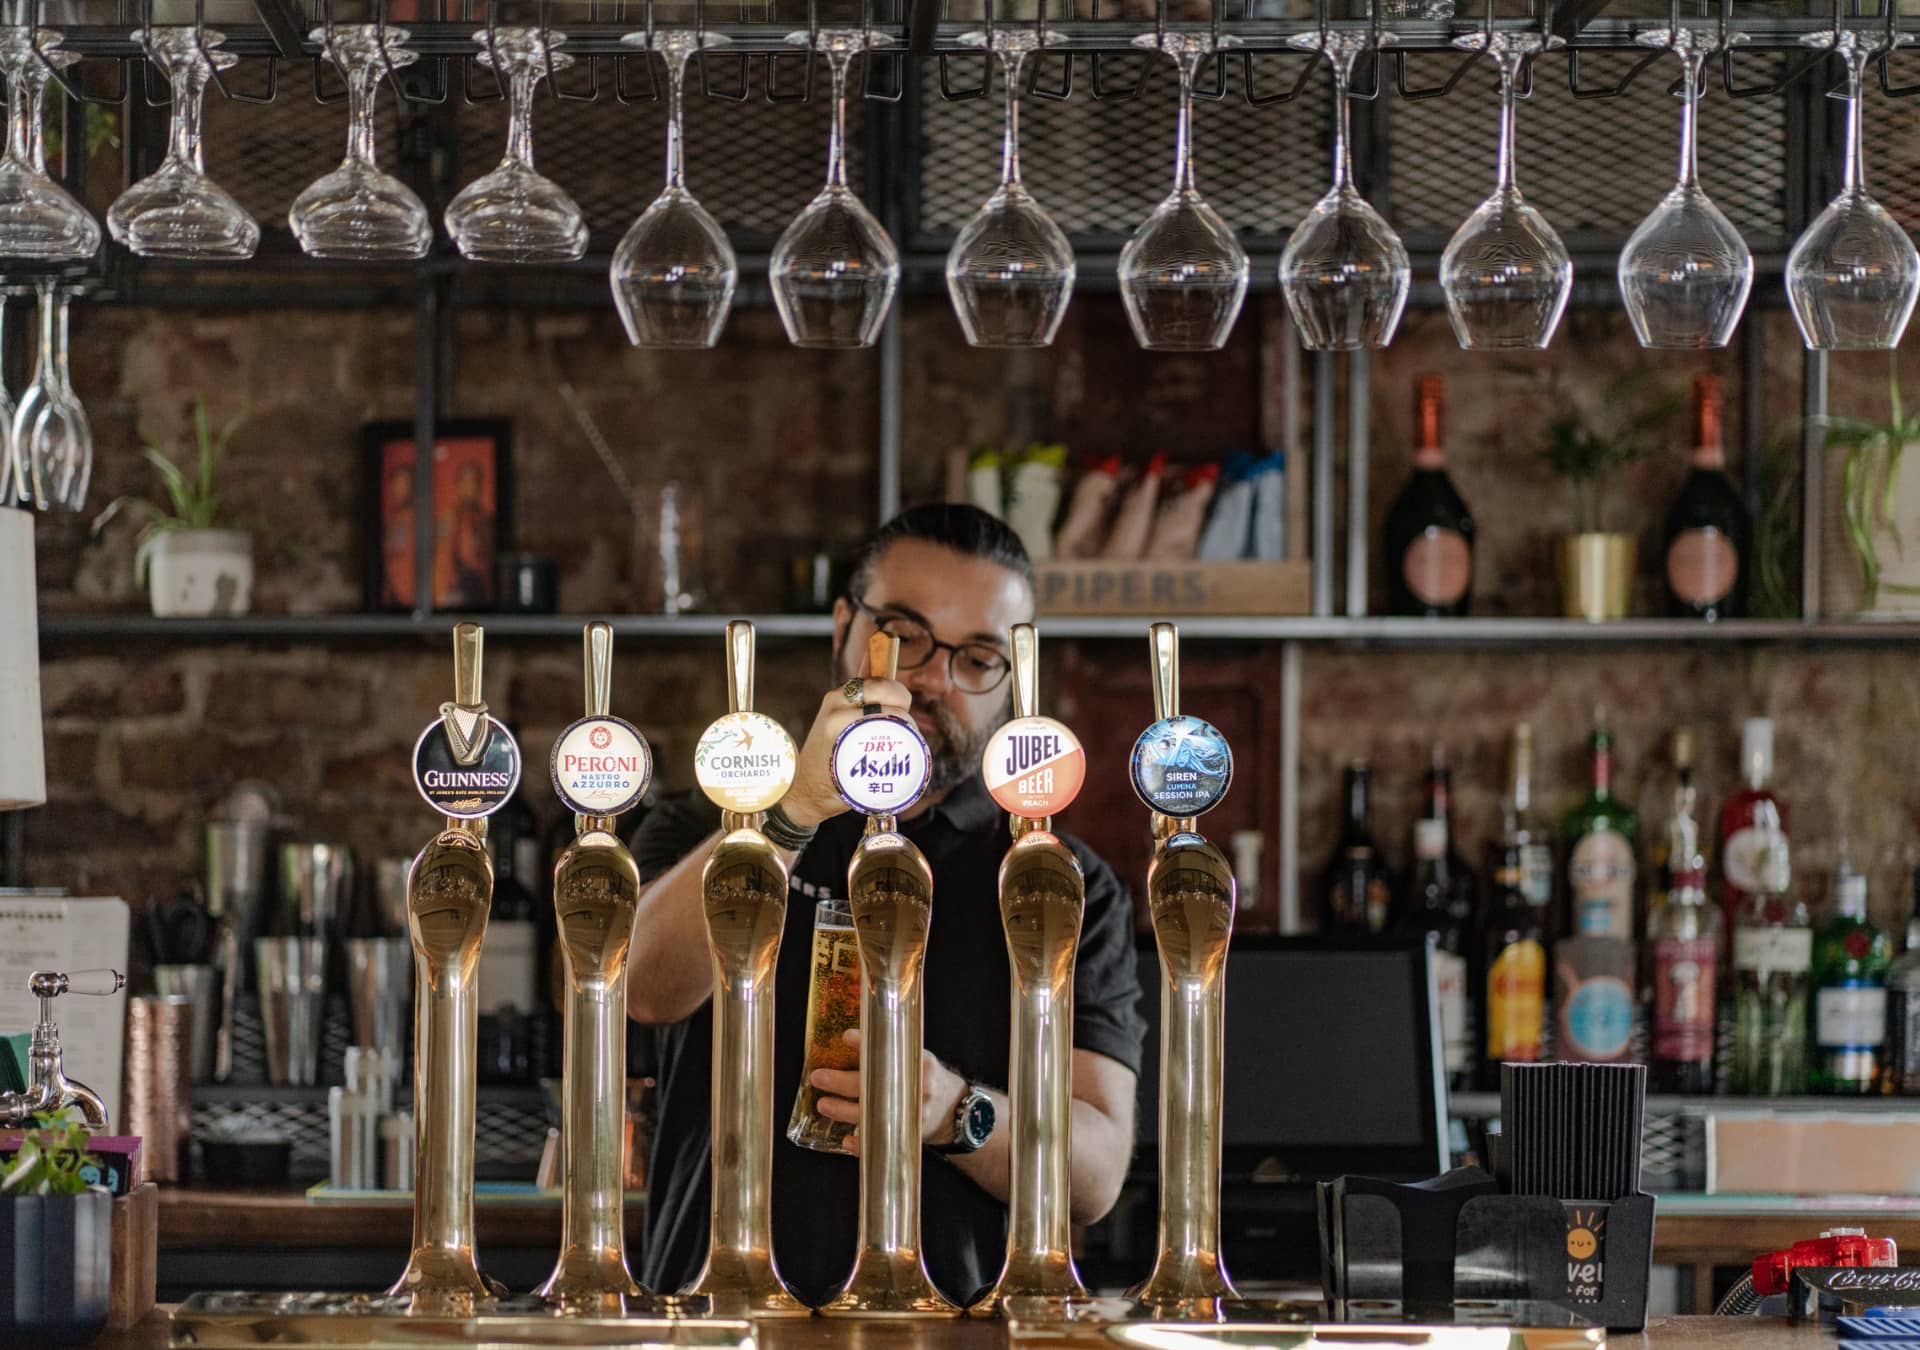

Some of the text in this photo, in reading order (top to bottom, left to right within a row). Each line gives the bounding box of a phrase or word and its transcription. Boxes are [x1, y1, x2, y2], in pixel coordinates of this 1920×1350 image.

[1044, 571, 1206, 609] PIPERS
[564, 754, 638, 772] PERONI
[711, 754, 781, 770] CORNISH
[1006, 735, 1061, 776] JUBEL
[850, 753, 910, 777] Asahi
[424, 770, 509, 787] GUINNESS
[720, 769, 771, 778] ORCHARDS
[1018, 767, 1053, 794] BEER
[1166, 772, 1197, 782] SIREN
[867, 782, 893, 794] 辛口
[1154, 790, 1210, 800] SESSION IPA
[1575, 1285, 1597, 1296] for
